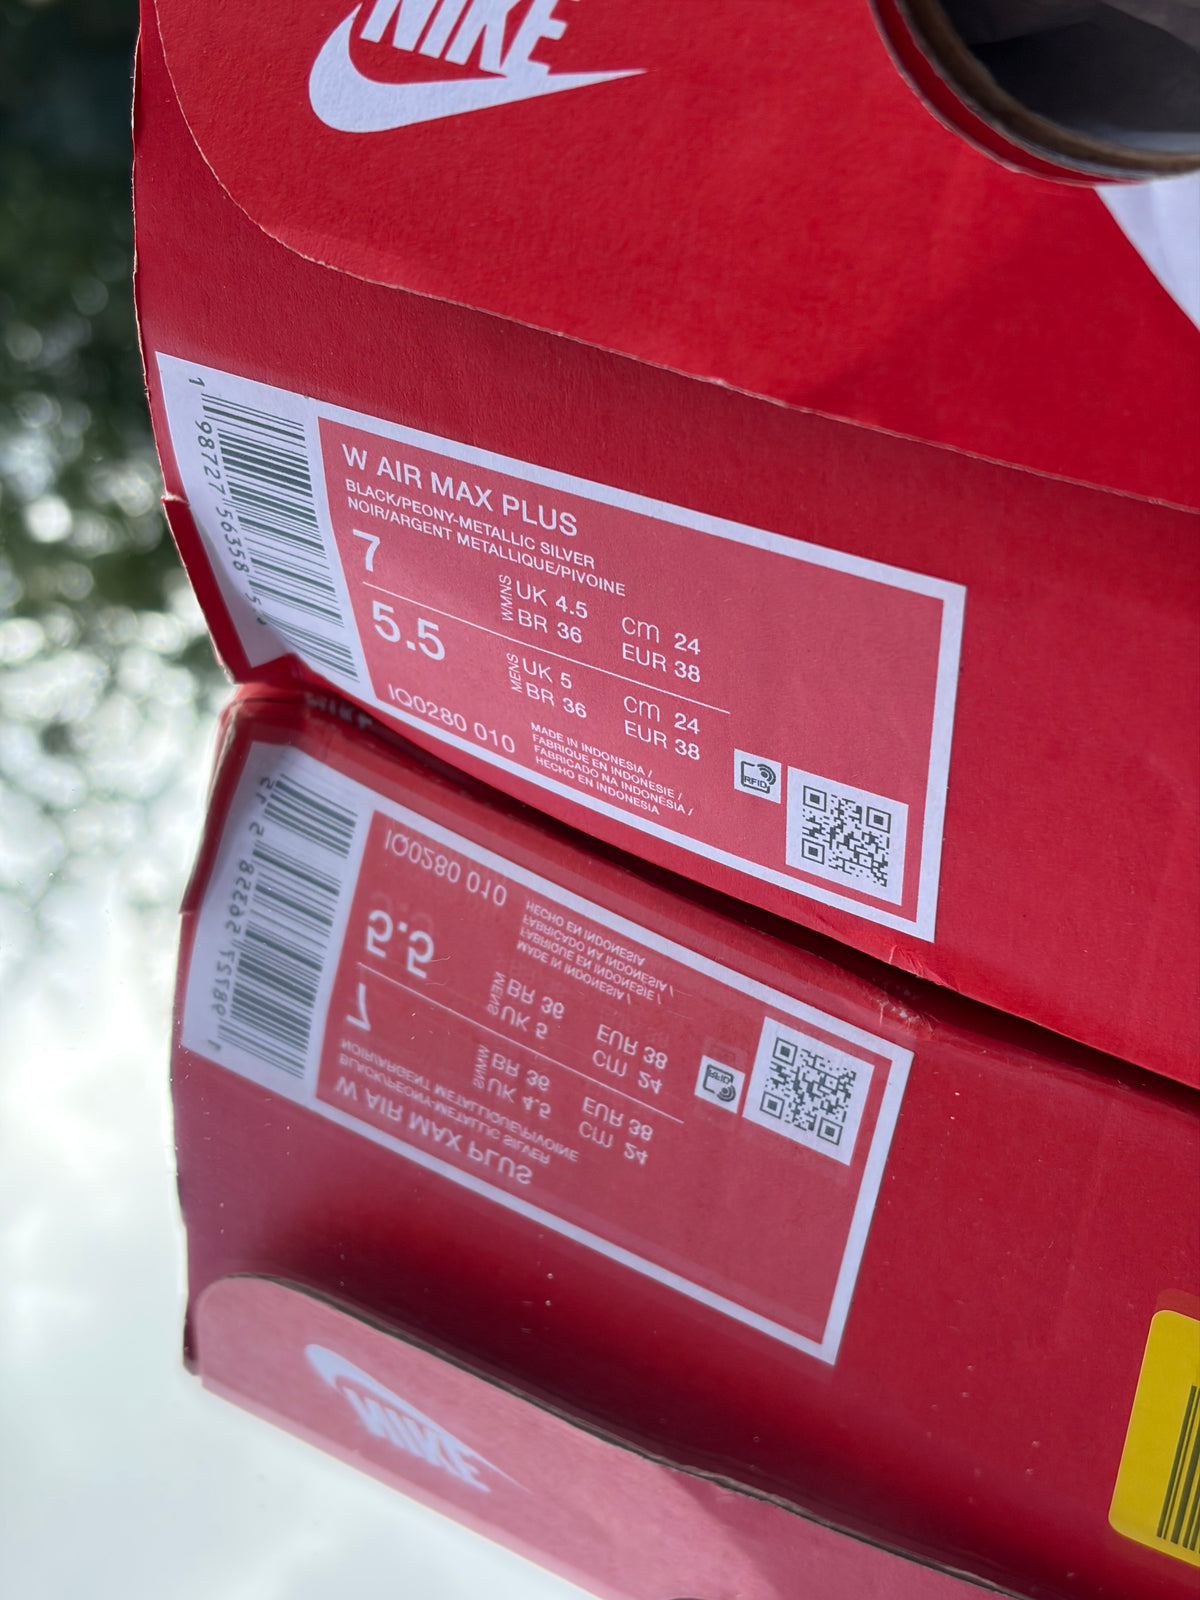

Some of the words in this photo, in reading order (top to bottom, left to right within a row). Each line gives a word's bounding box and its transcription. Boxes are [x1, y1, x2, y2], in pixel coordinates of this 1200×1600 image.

[188, 377, 206, 388] 1
[195, 420, 226, 495] 98727
[341, 443, 368, 470] W
[377, 456, 422, 489] AIR
[431, 471, 493, 512] MAX
[502, 494, 578, 537] PLUS
[215, 506, 250, 573] 56358
[345, 479, 535, 550] BLACK/PEONY-METALLIC
[540, 541, 595, 569] SILVER
[348, 497, 452, 541] NOIR/ARGENT
[457, 532, 626, 597] METALLIQUE/PIVOINE
[352, 529, 381, 572] 7
[499, 575, 514, 622] WMNS
[516, 580, 548, 607] UK
[555, 596, 589, 620] 4.5
[372, 600, 445, 661] 5.5
[518, 610, 548, 633] BR
[557, 623, 583, 644] 36
[674, 632, 701, 655] 24
[506, 653, 523, 693] MENS
[522, 658, 553, 684] UK
[560, 672, 572, 689] 5
[622, 642, 667, 673] EUR
[674, 661, 701, 683] 38
[387, 683, 467, 733] IQ0280
[474, 723, 515, 753] 010
[526, 682, 555, 707] BR
[562, 698, 587, 718] 36
[624, 720, 668, 749] EUR
[674, 739, 701, 760] 38
[673, 712, 700, 735] 24
[530, 721, 564, 742] MADE
[567, 736, 578, 748] IN
[581, 742, 646, 776] INDONESIA
[532, 733, 590, 765] FABRIQUE
[592, 758, 608, 773] EN
[611, 765, 674, 799] INDONESIE
[534, 744, 599, 778] FABRICADO
[602, 772, 619, 787] NA
[535, 756, 575, 780] HECHO
[578, 772, 593, 788] EN
[596, 780, 660, 816] INDONESIA
[744, 775, 768, 789] RFID
